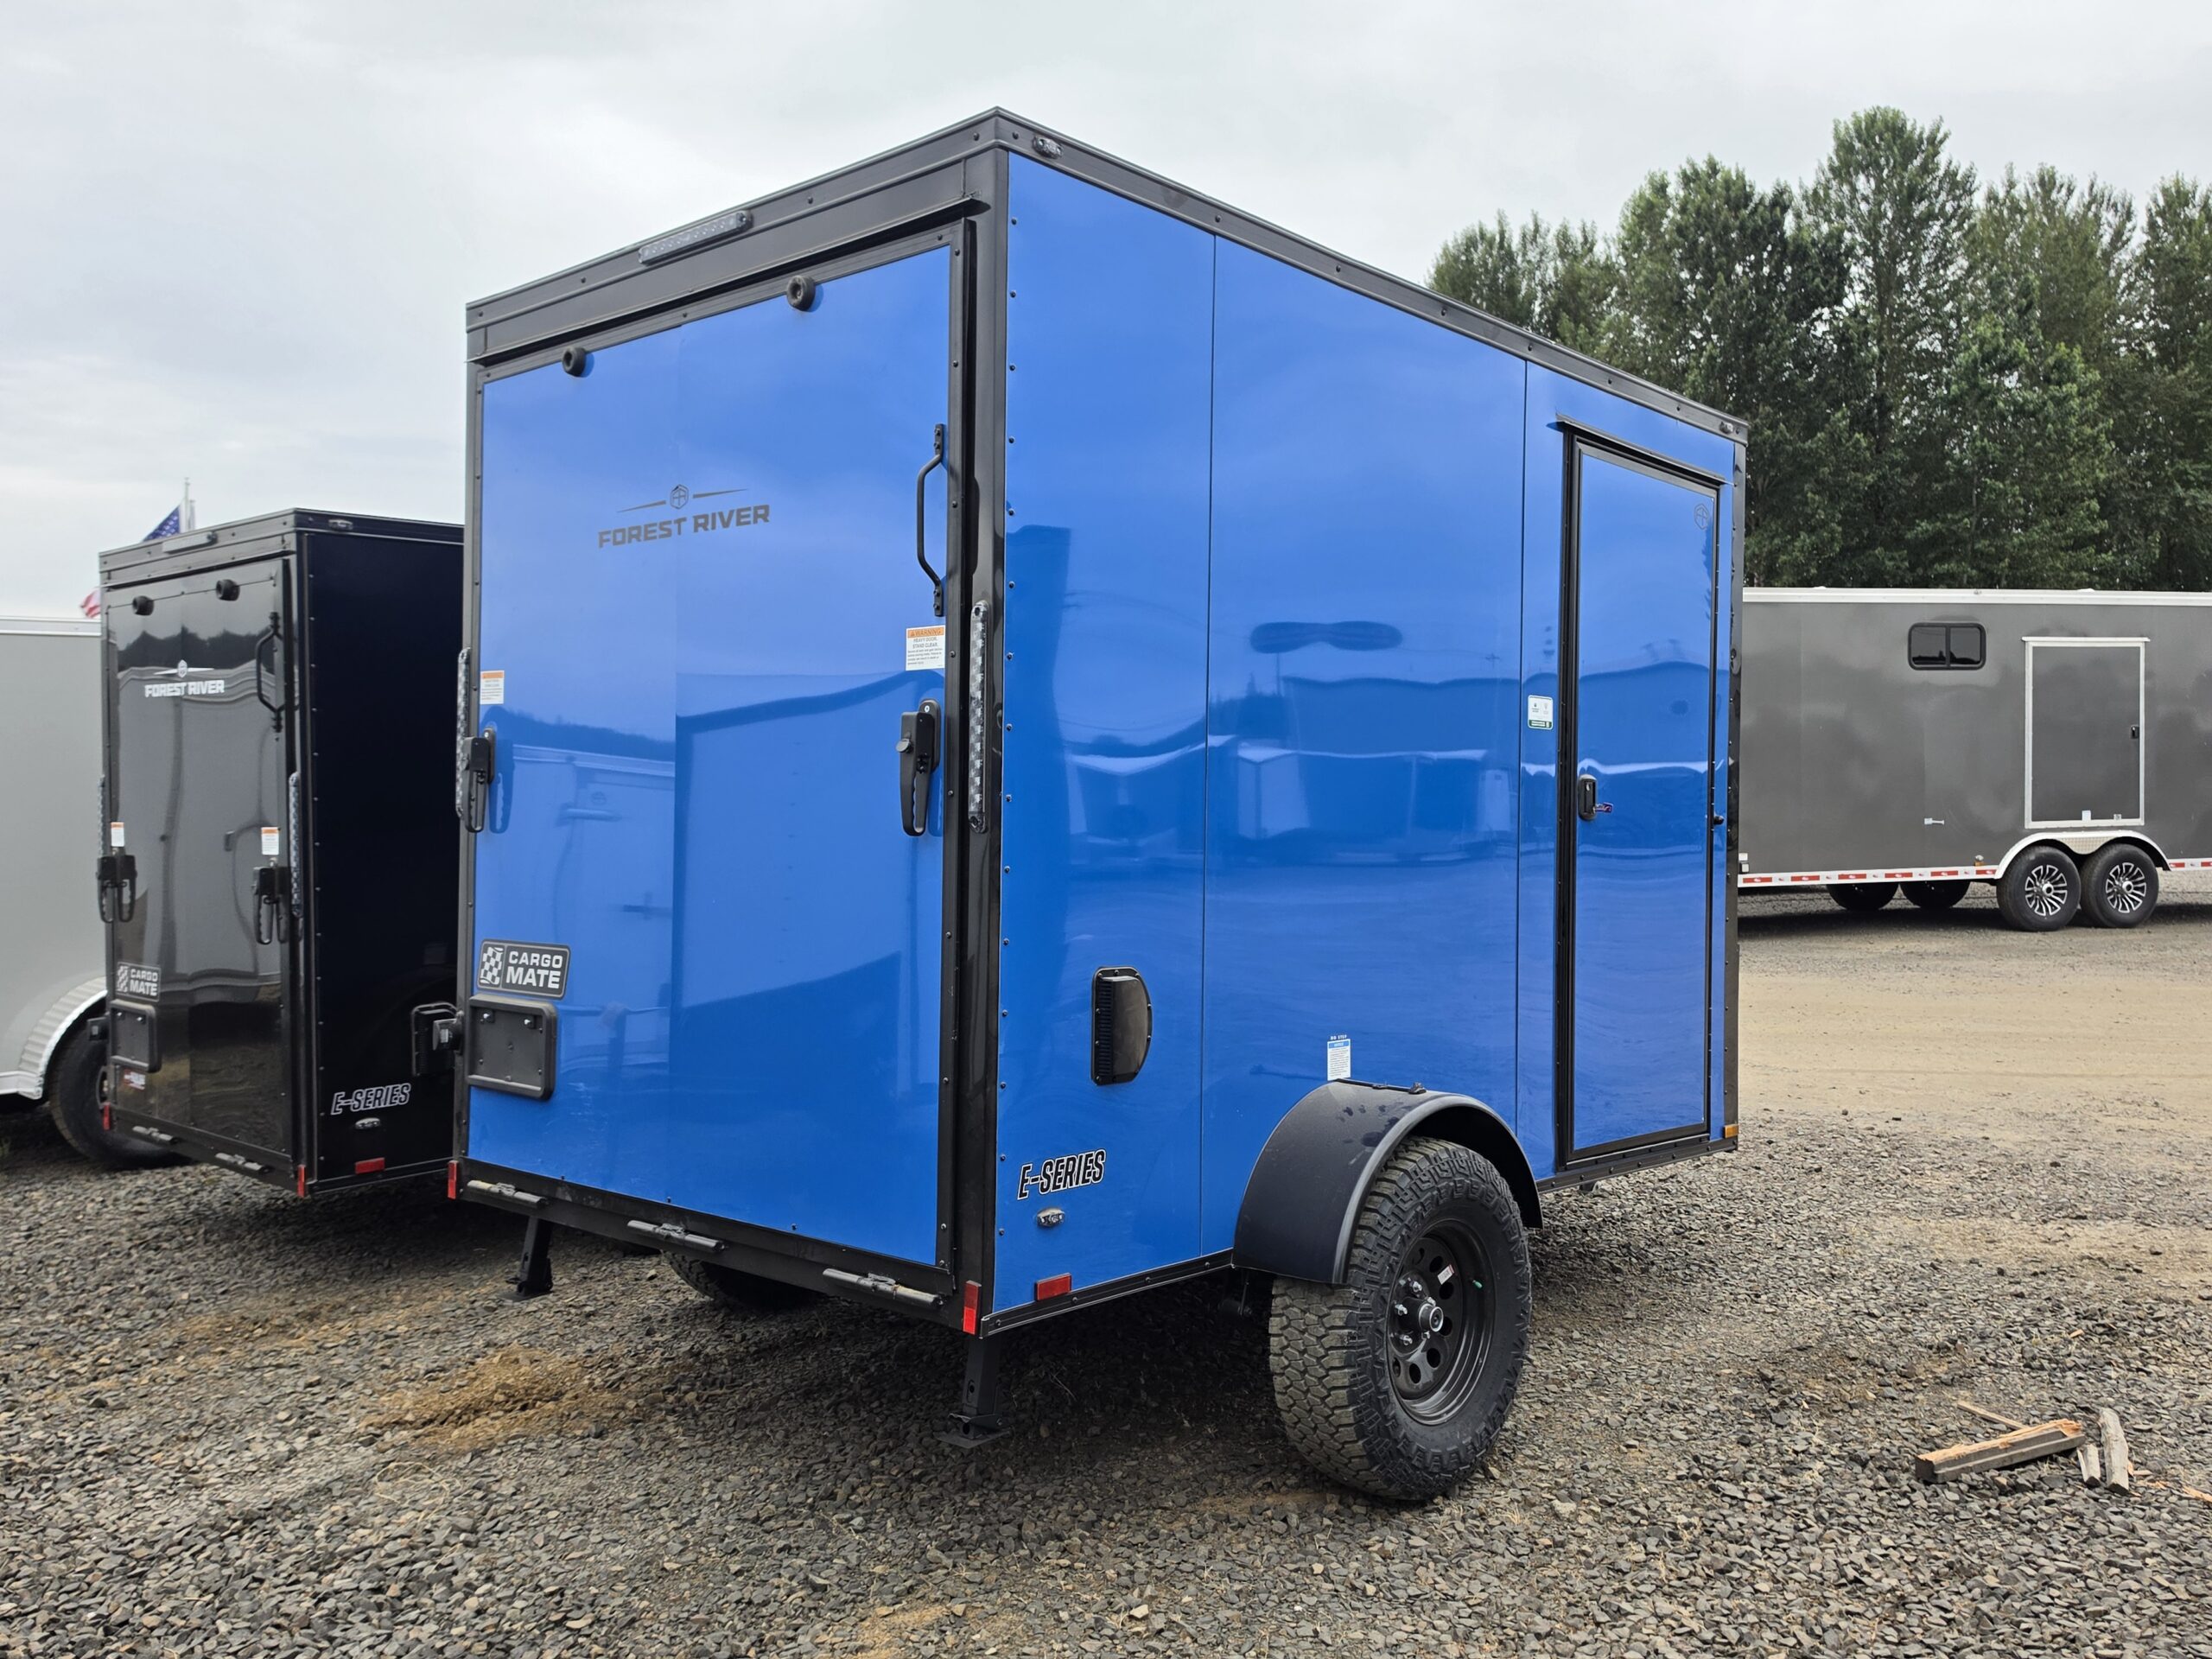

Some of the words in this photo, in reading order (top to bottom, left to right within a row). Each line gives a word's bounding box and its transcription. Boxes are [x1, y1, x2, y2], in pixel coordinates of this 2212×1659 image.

[598, 517, 688, 549] FOREST
[692, 504, 771, 533] RIVER
[914, 626, 942, 638] WARNING
[144, 682, 187, 698] FOREST
[188, 679, 225, 696] RIVER
[508, 950, 563, 969] CARGO
[130, 968, 158, 982] CARGO
[505, 965, 562, 989] MATE
[130, 979, 157, 996] MATE
[330, 1082, 412, 1116] E-SERIES
[1016, 1148, 1107, 1201] E-SERIES
